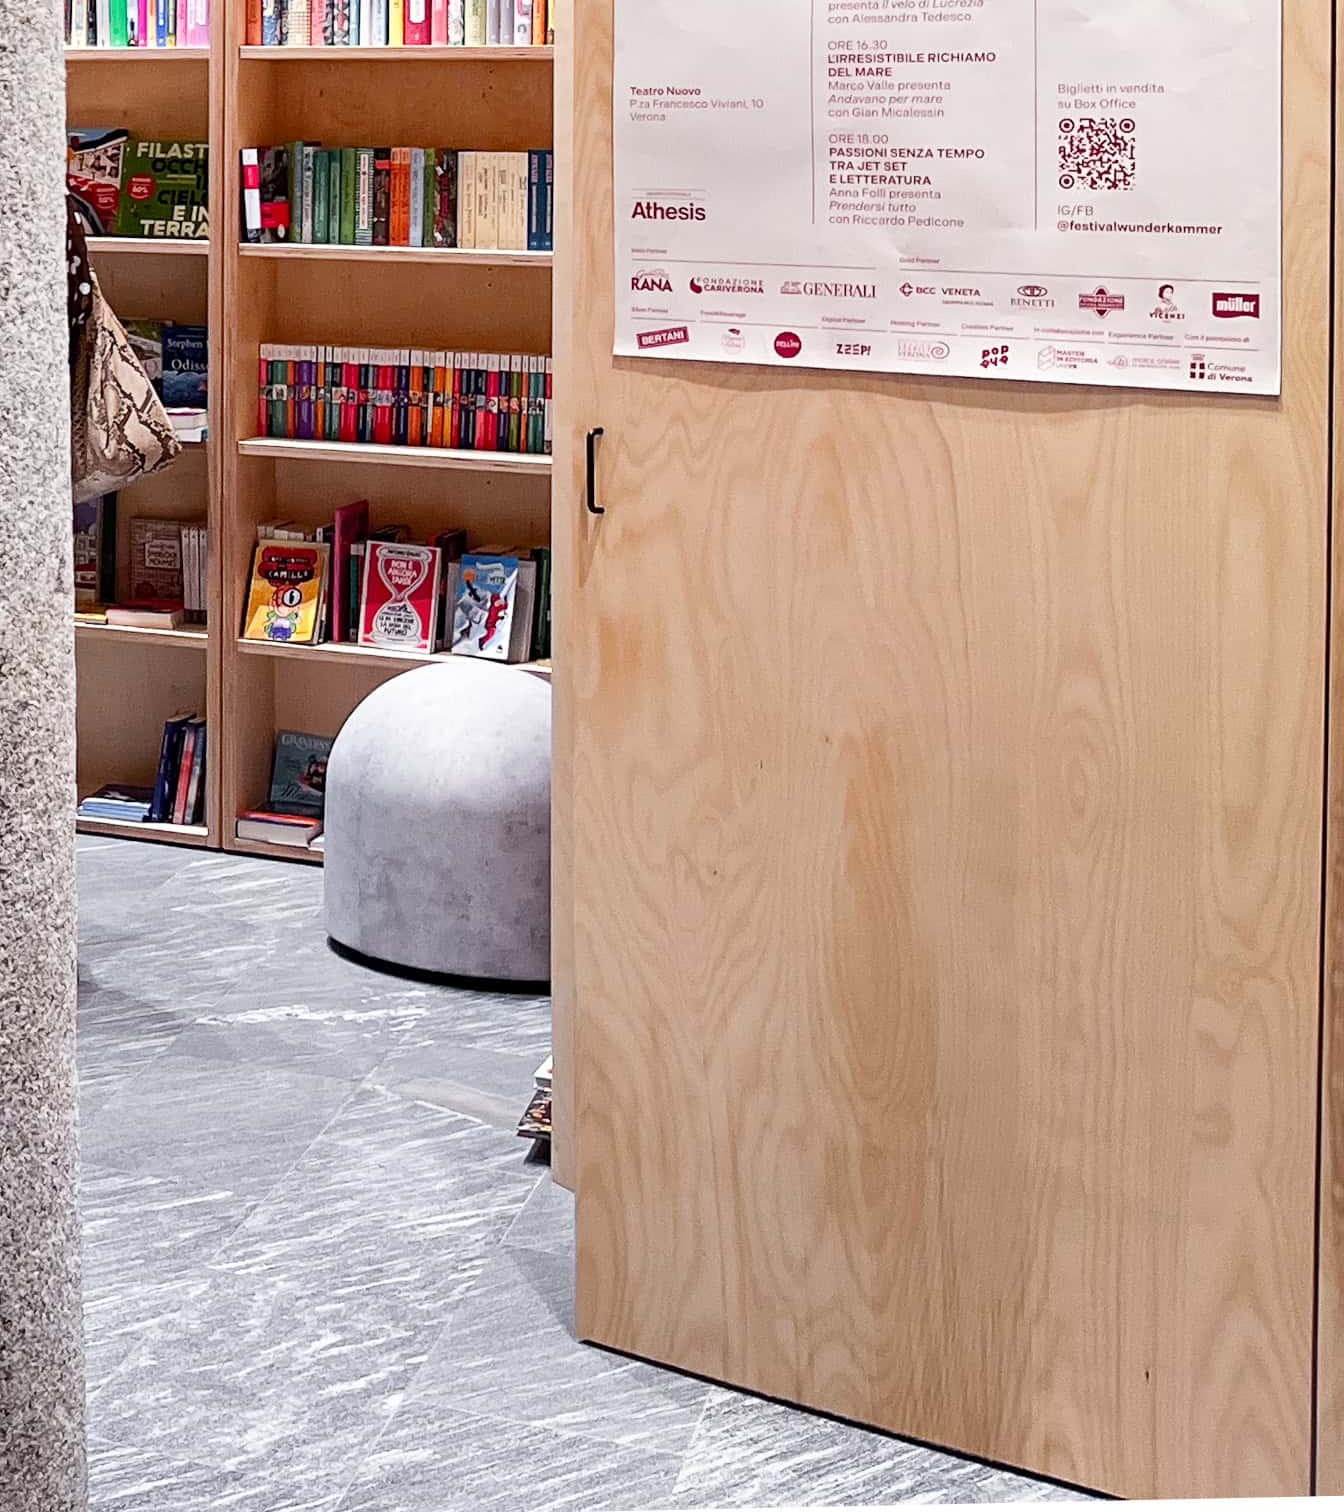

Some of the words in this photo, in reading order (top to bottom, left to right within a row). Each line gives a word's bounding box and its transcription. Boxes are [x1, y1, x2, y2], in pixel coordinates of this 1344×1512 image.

[927, 52, 996, 63] RICHIAMO
[828, 68, 853, 78] DEL
[855, 67, 892, 77] MARE
[630, 86, 664, 96] Teatro
[666, 87, 701, 96] Nuovo
[1119, 83, 1165, 94] vendita
[829, 147, 888, 158] PASSIONI
[890, 148, 933, 159] SENZA
[936, 148, 985, 159] TEMPO
[830, 161, 854, 170] TRA
[857, 161, 880, 171] JET
[883, 161, 907, 171] SET
[829, 174, 836, 184] E
[839, 175, 932, 186] LETTERATURA
[631, 201, 707, 221] Athesis
[1058, 204, 1094, 217] IG/FB
[140, 219, 209, 236] TERRA
[1057, 220, 1222, 235] @festivalwunderkammer
[631, 276, 673, 293] RANA
[803, 282, 877, 299] GENERALI
[1217, 294, 1256, 313] müller
[641, 329, 685, 346] BERTANI
